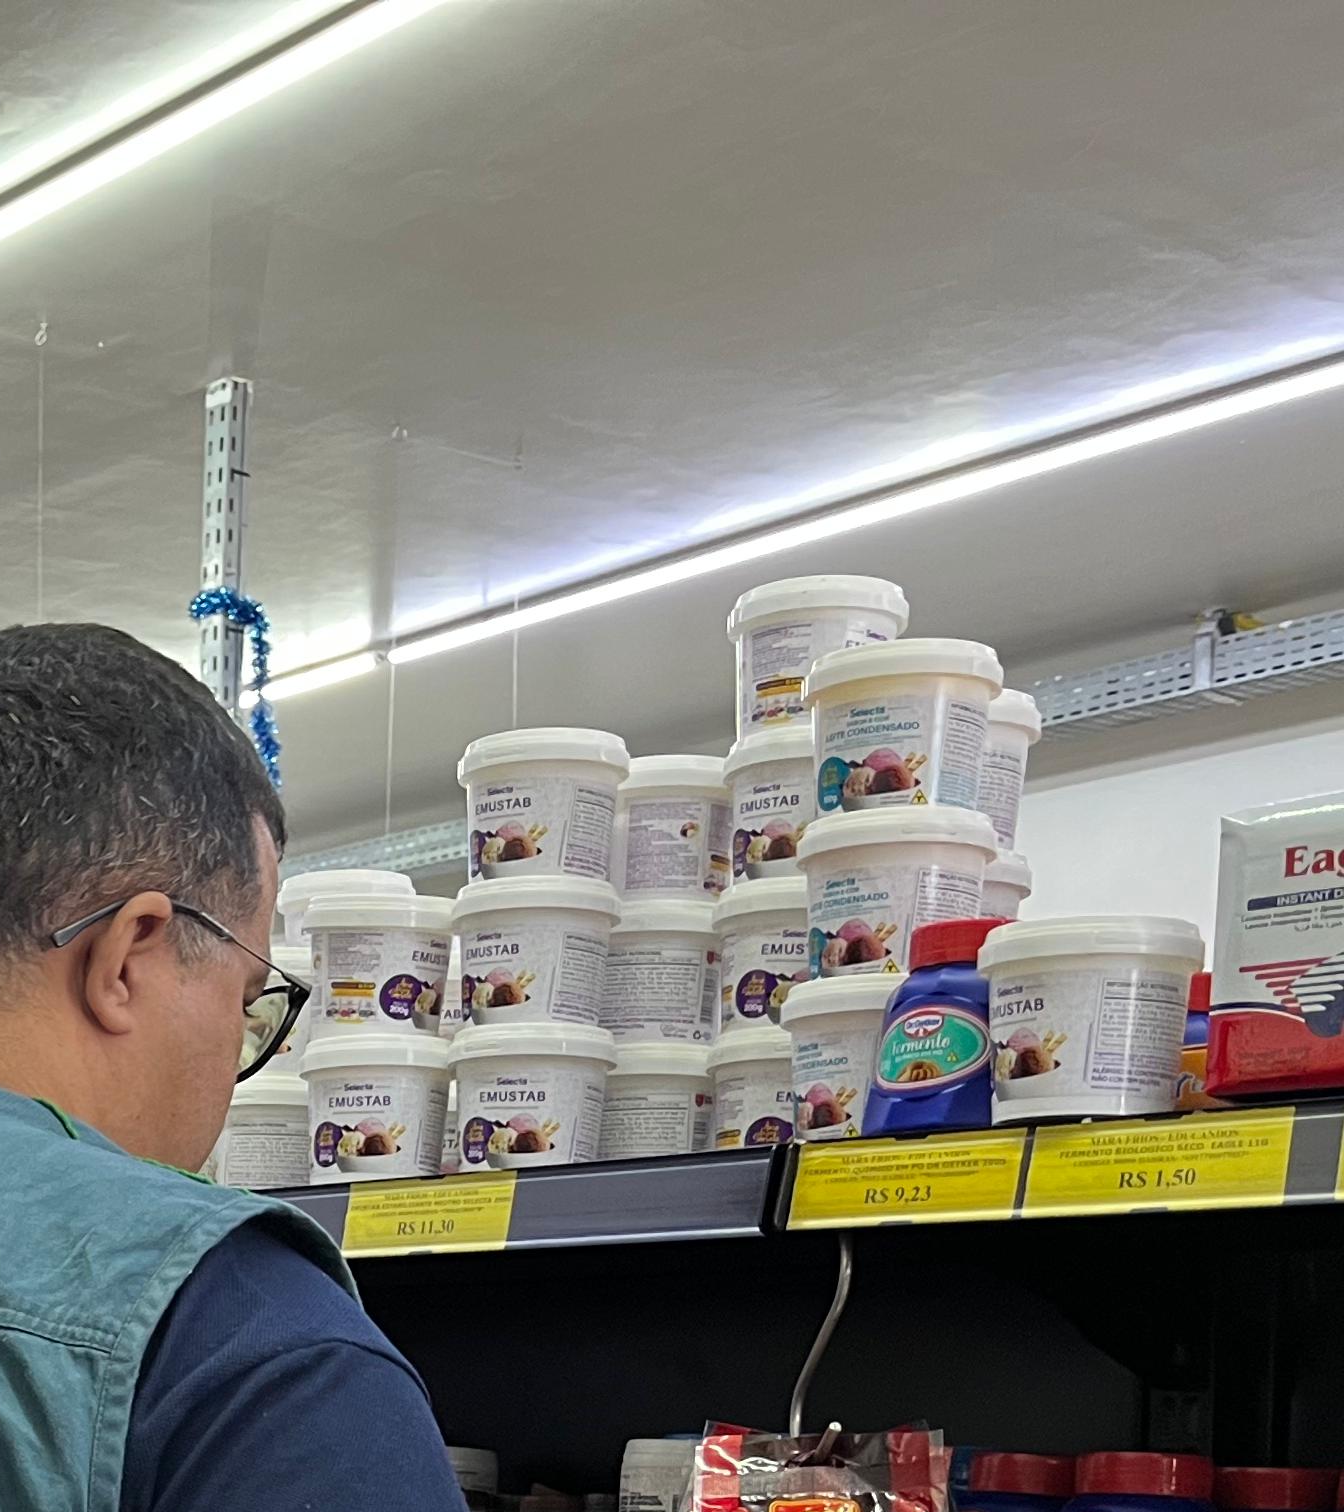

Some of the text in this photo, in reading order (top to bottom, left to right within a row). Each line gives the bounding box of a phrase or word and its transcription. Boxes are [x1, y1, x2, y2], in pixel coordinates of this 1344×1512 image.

[847, 721, 920, 738] CONDENSADO
[475, 797, 532, 815] EMUSTAB
[740, 795, 801, 814] EMUSTAB
[783, 929, 807, 938] Selec
[466, 944, 520, 961] EMUSTAB
[990, 999, 1045, 1019] MUSTAB
[328, 1095, 391, 1108] EMUSTAB
[480, 1091, 546, 1103] EMUSTAB
[1126, 1134, 1159, 1145] FRIOS
[1059, 1149, 1112, 1159] FERMENTO
[1177, 1143, 1205, 1152] SECO
[1211, 1140, 1244, 1149] EAGLE
[1155, 1168, 1196, 1188] 1,50
[895, 1185, 932, 1203] 9,23
[420, 1219, 454, 1235] 11,30
